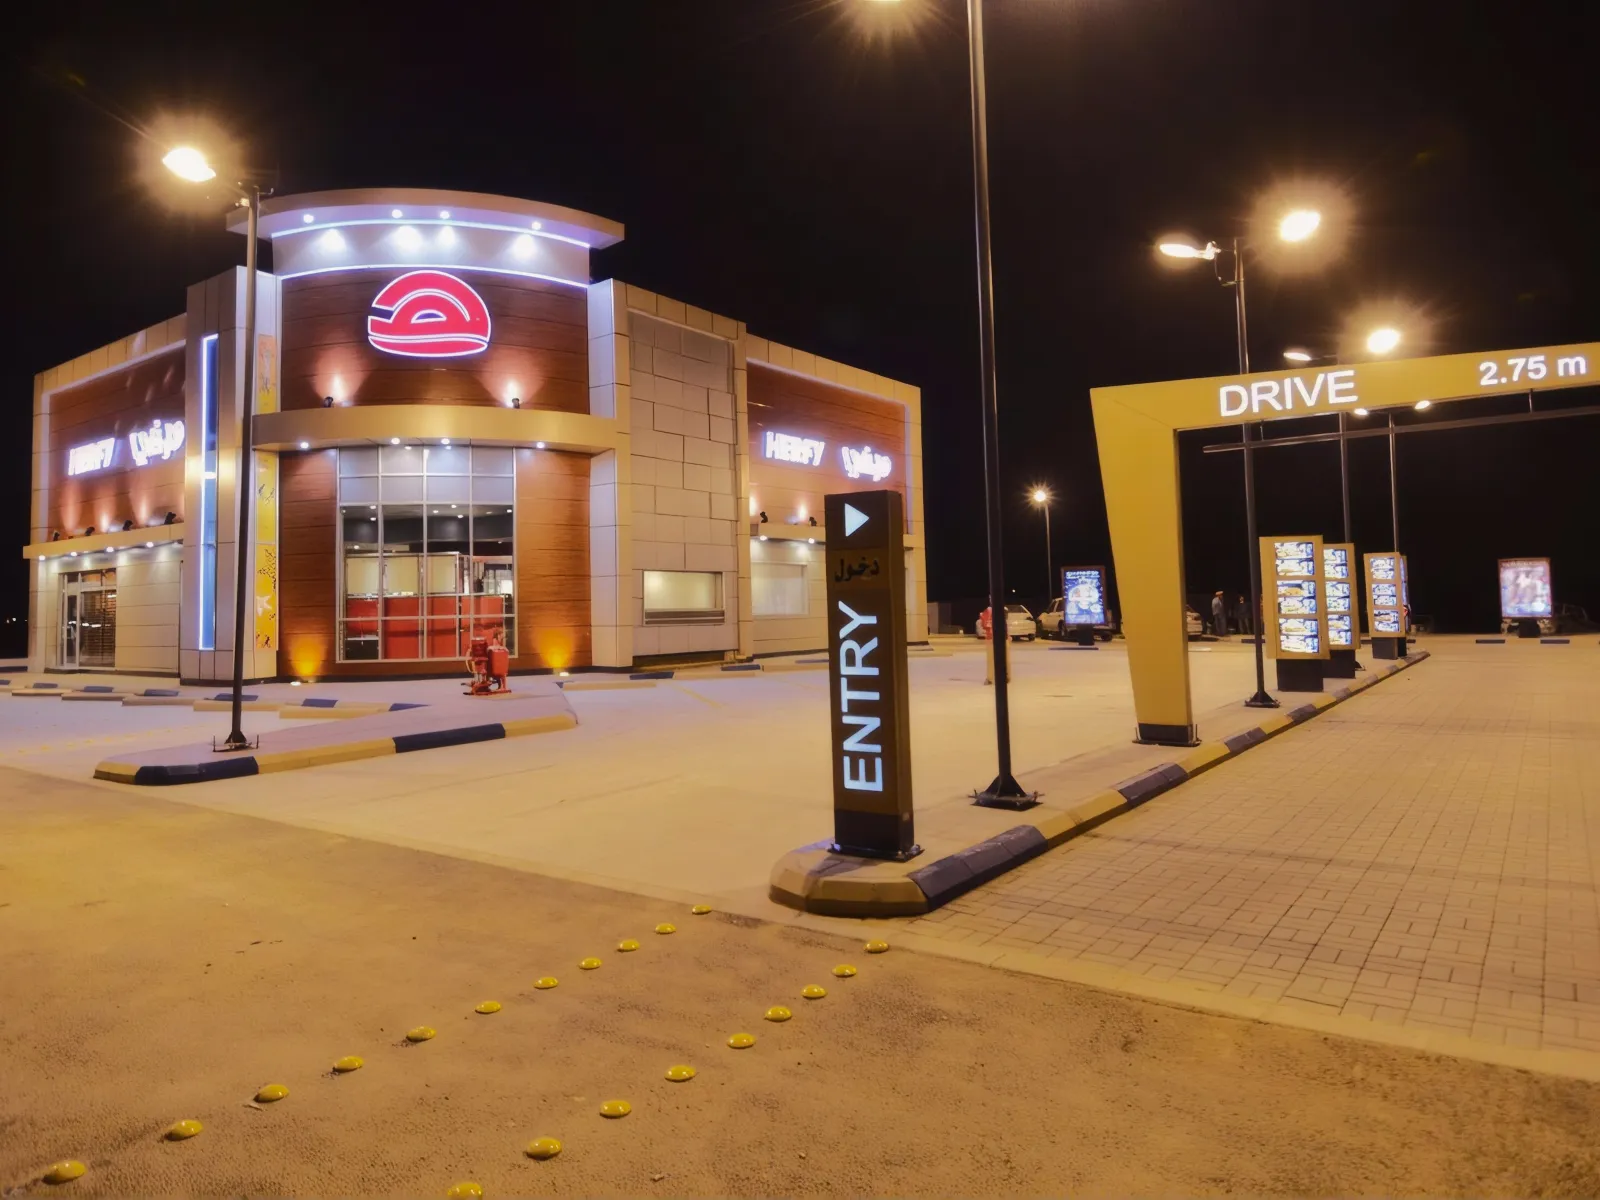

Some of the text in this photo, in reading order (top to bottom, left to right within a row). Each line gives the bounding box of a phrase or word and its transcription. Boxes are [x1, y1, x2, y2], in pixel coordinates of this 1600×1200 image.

[1479, 355, 1587, 386] 2.75 m
[1219, 369, 1359, 418] DRIVE
[834, 556, 880, 583] دخول
[838, 600, 884, 792] ENTRY
